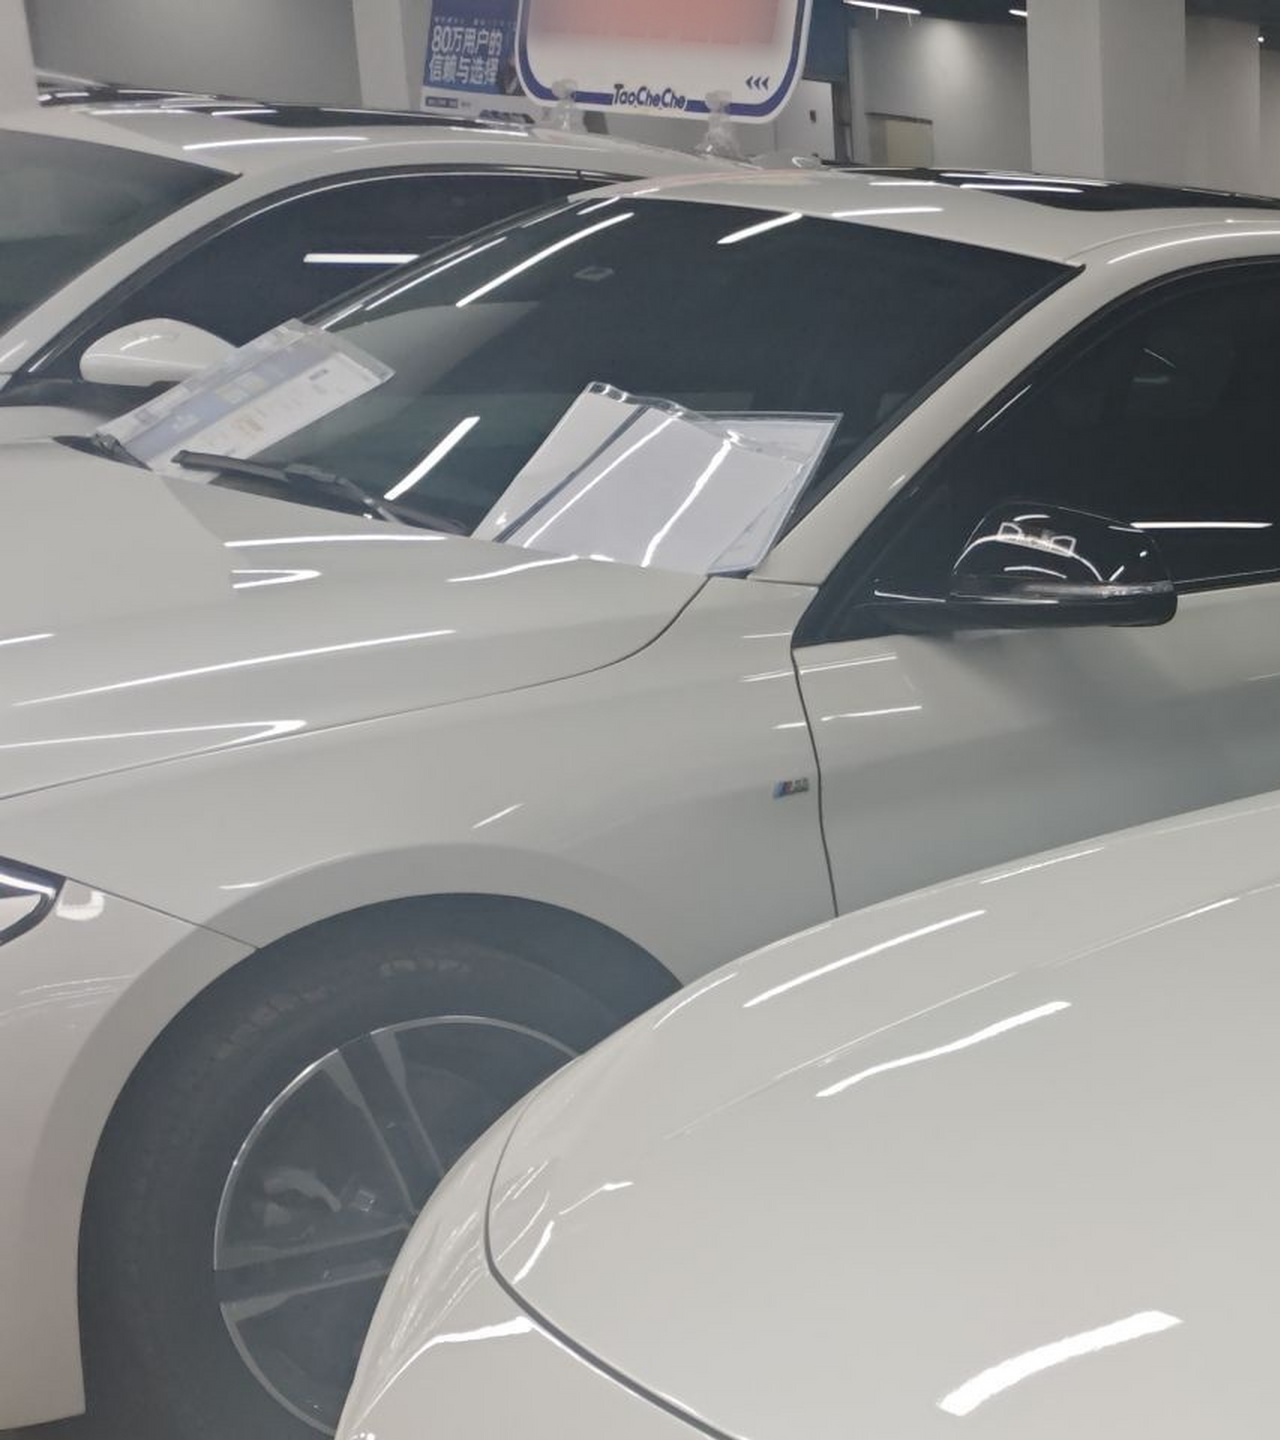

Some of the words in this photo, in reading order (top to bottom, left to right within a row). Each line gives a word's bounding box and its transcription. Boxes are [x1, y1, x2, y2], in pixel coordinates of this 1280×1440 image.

[431, 25, 503, 56] 80万用户的
[613, 83, 687, 110] TaoCheChe
